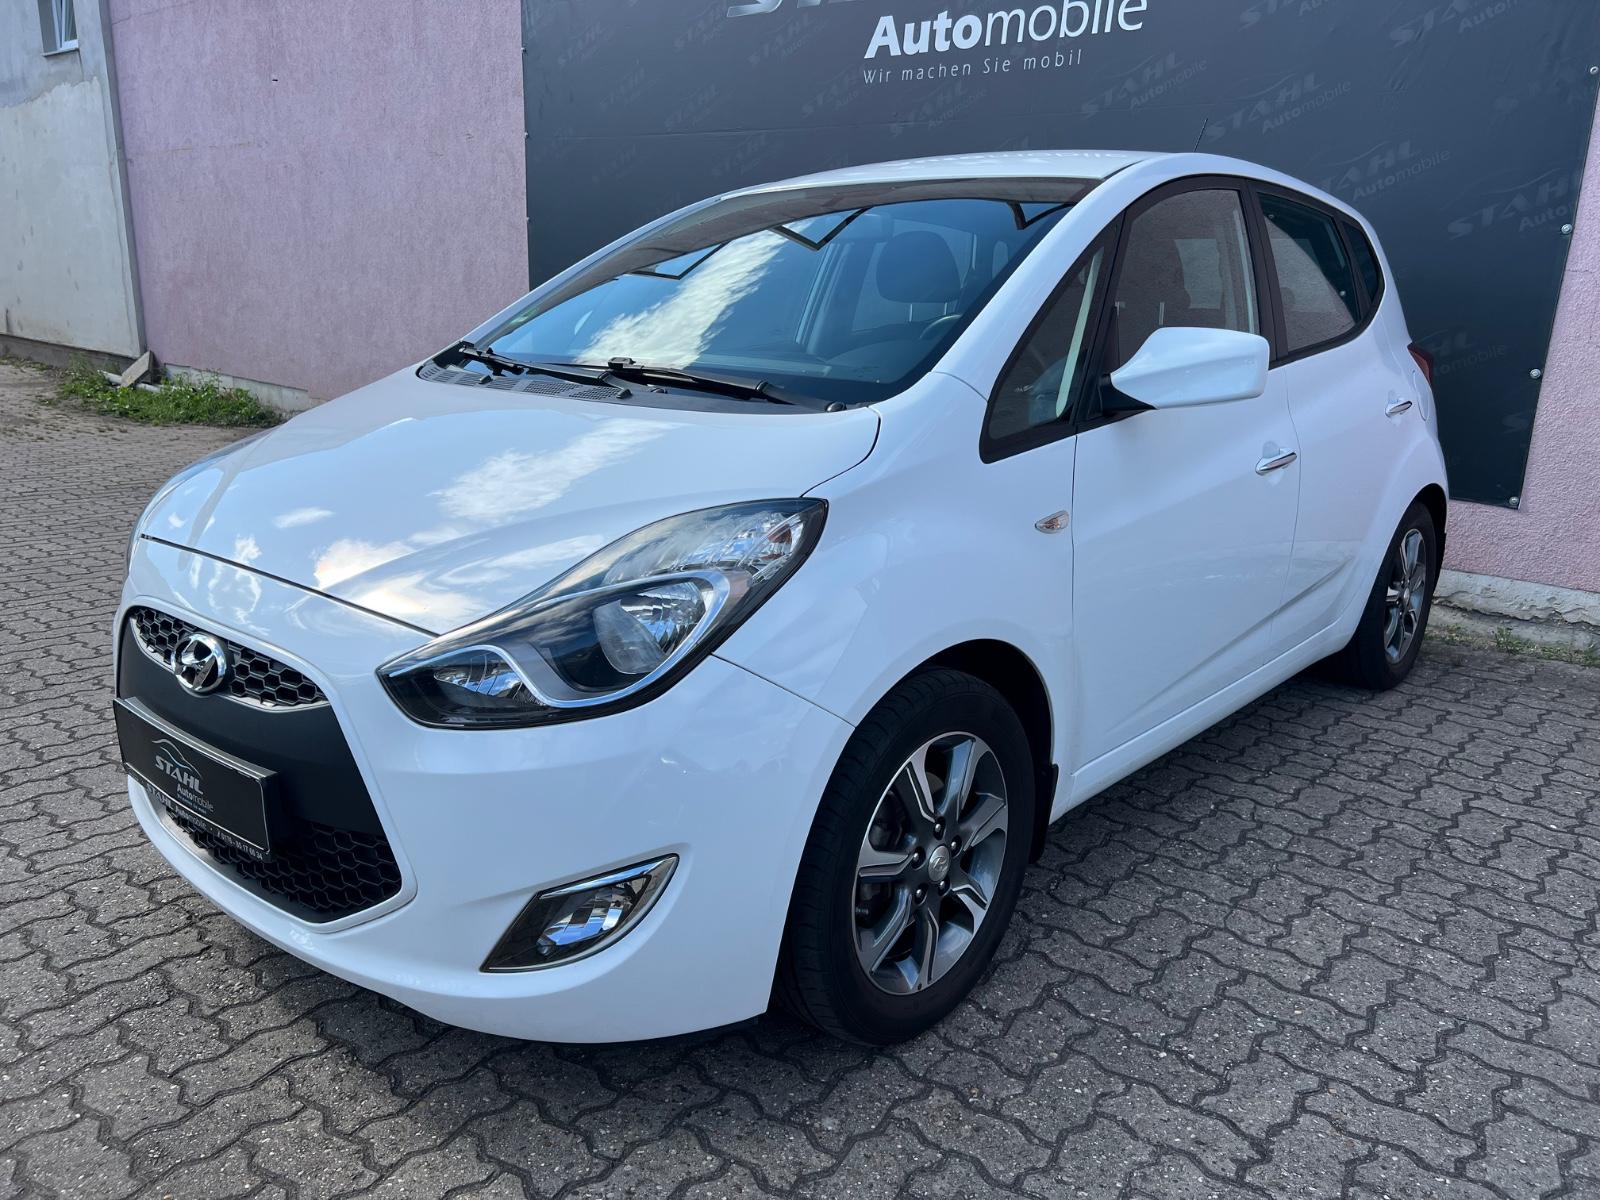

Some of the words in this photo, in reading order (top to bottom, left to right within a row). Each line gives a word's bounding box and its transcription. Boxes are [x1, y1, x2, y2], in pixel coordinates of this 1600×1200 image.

[864, 0, 1150, 58] Automobile
[863, 67, 892, 86] Wir
[901, 62, 972, 82] machen
[983, 57, 1011, 75] Sie
[1023, 49, 1084, 72] mobil
[1081, 51, 1184, 120] STAHL
[1130, 58, 1208, 109] Automobile
[1206, 72, 1326, 142] STAHL
[1262, 81, 1351, 134] Automobile
[1320, 140, 1422, 192] TAHL
[1352, 150, 1450, 200] Automobile
[155, 755, 204, 795] STAHL
